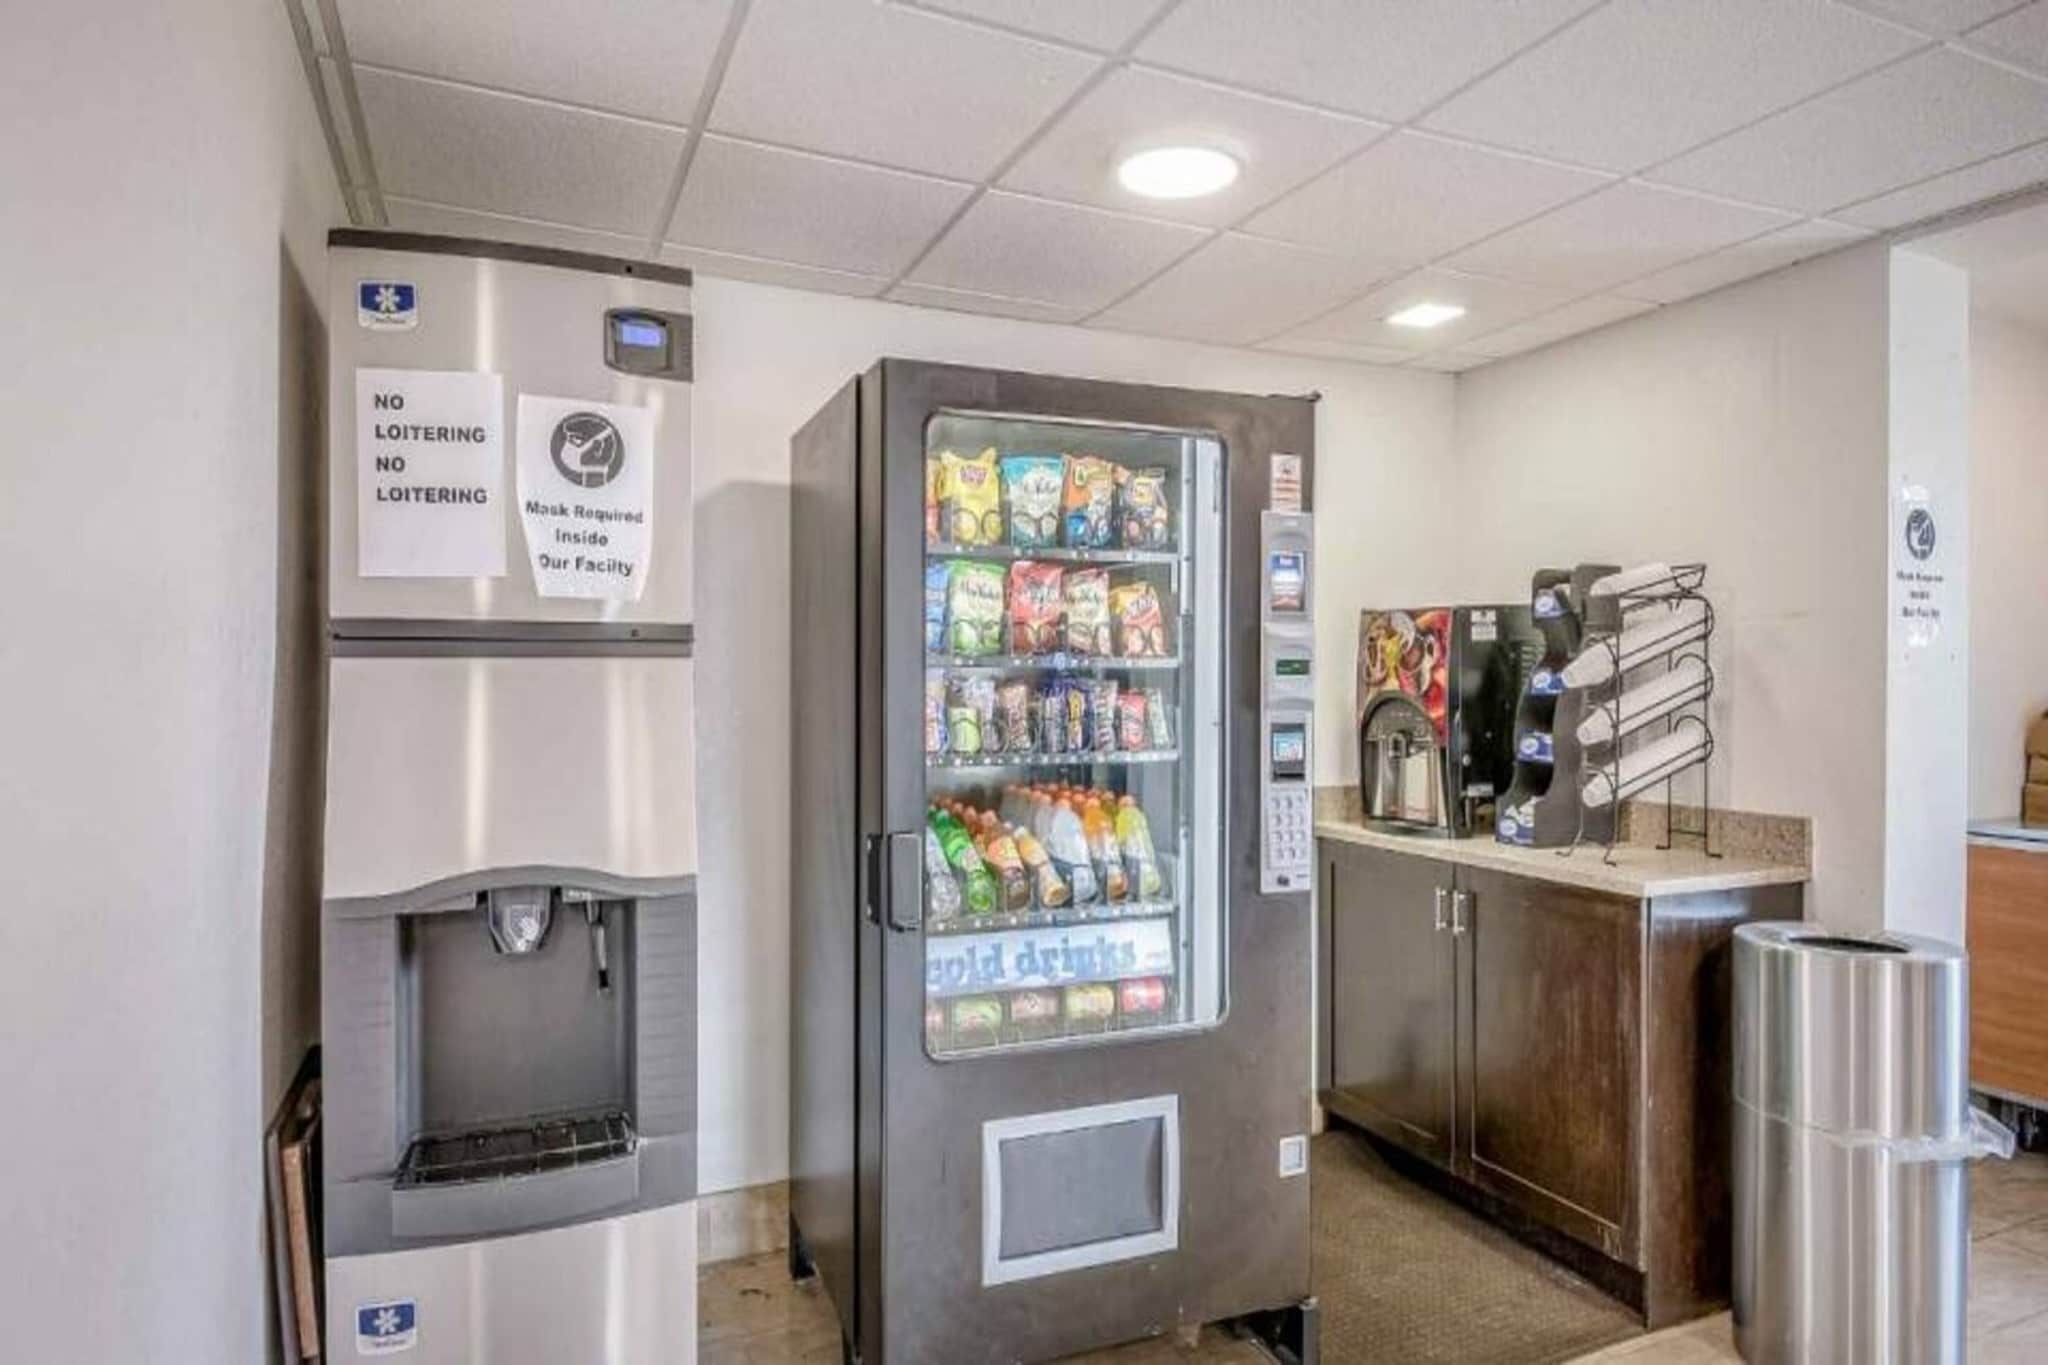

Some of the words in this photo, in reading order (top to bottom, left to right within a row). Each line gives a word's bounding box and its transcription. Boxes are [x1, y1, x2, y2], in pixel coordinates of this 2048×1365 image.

[375, 394, 404, 410] NO
[375, 424, 485, 443] LOITERING
[376, 456, 405, 472] NO
[377, 486, 487, 504] LOITERING
[526, 500, 569, 516] Mask
[574, 504, 643, 523] Required
[556, 527, 608, 546] Inside
[539, 553, 569, 570] Our
[1016, 936, 1135, 977] drinks
